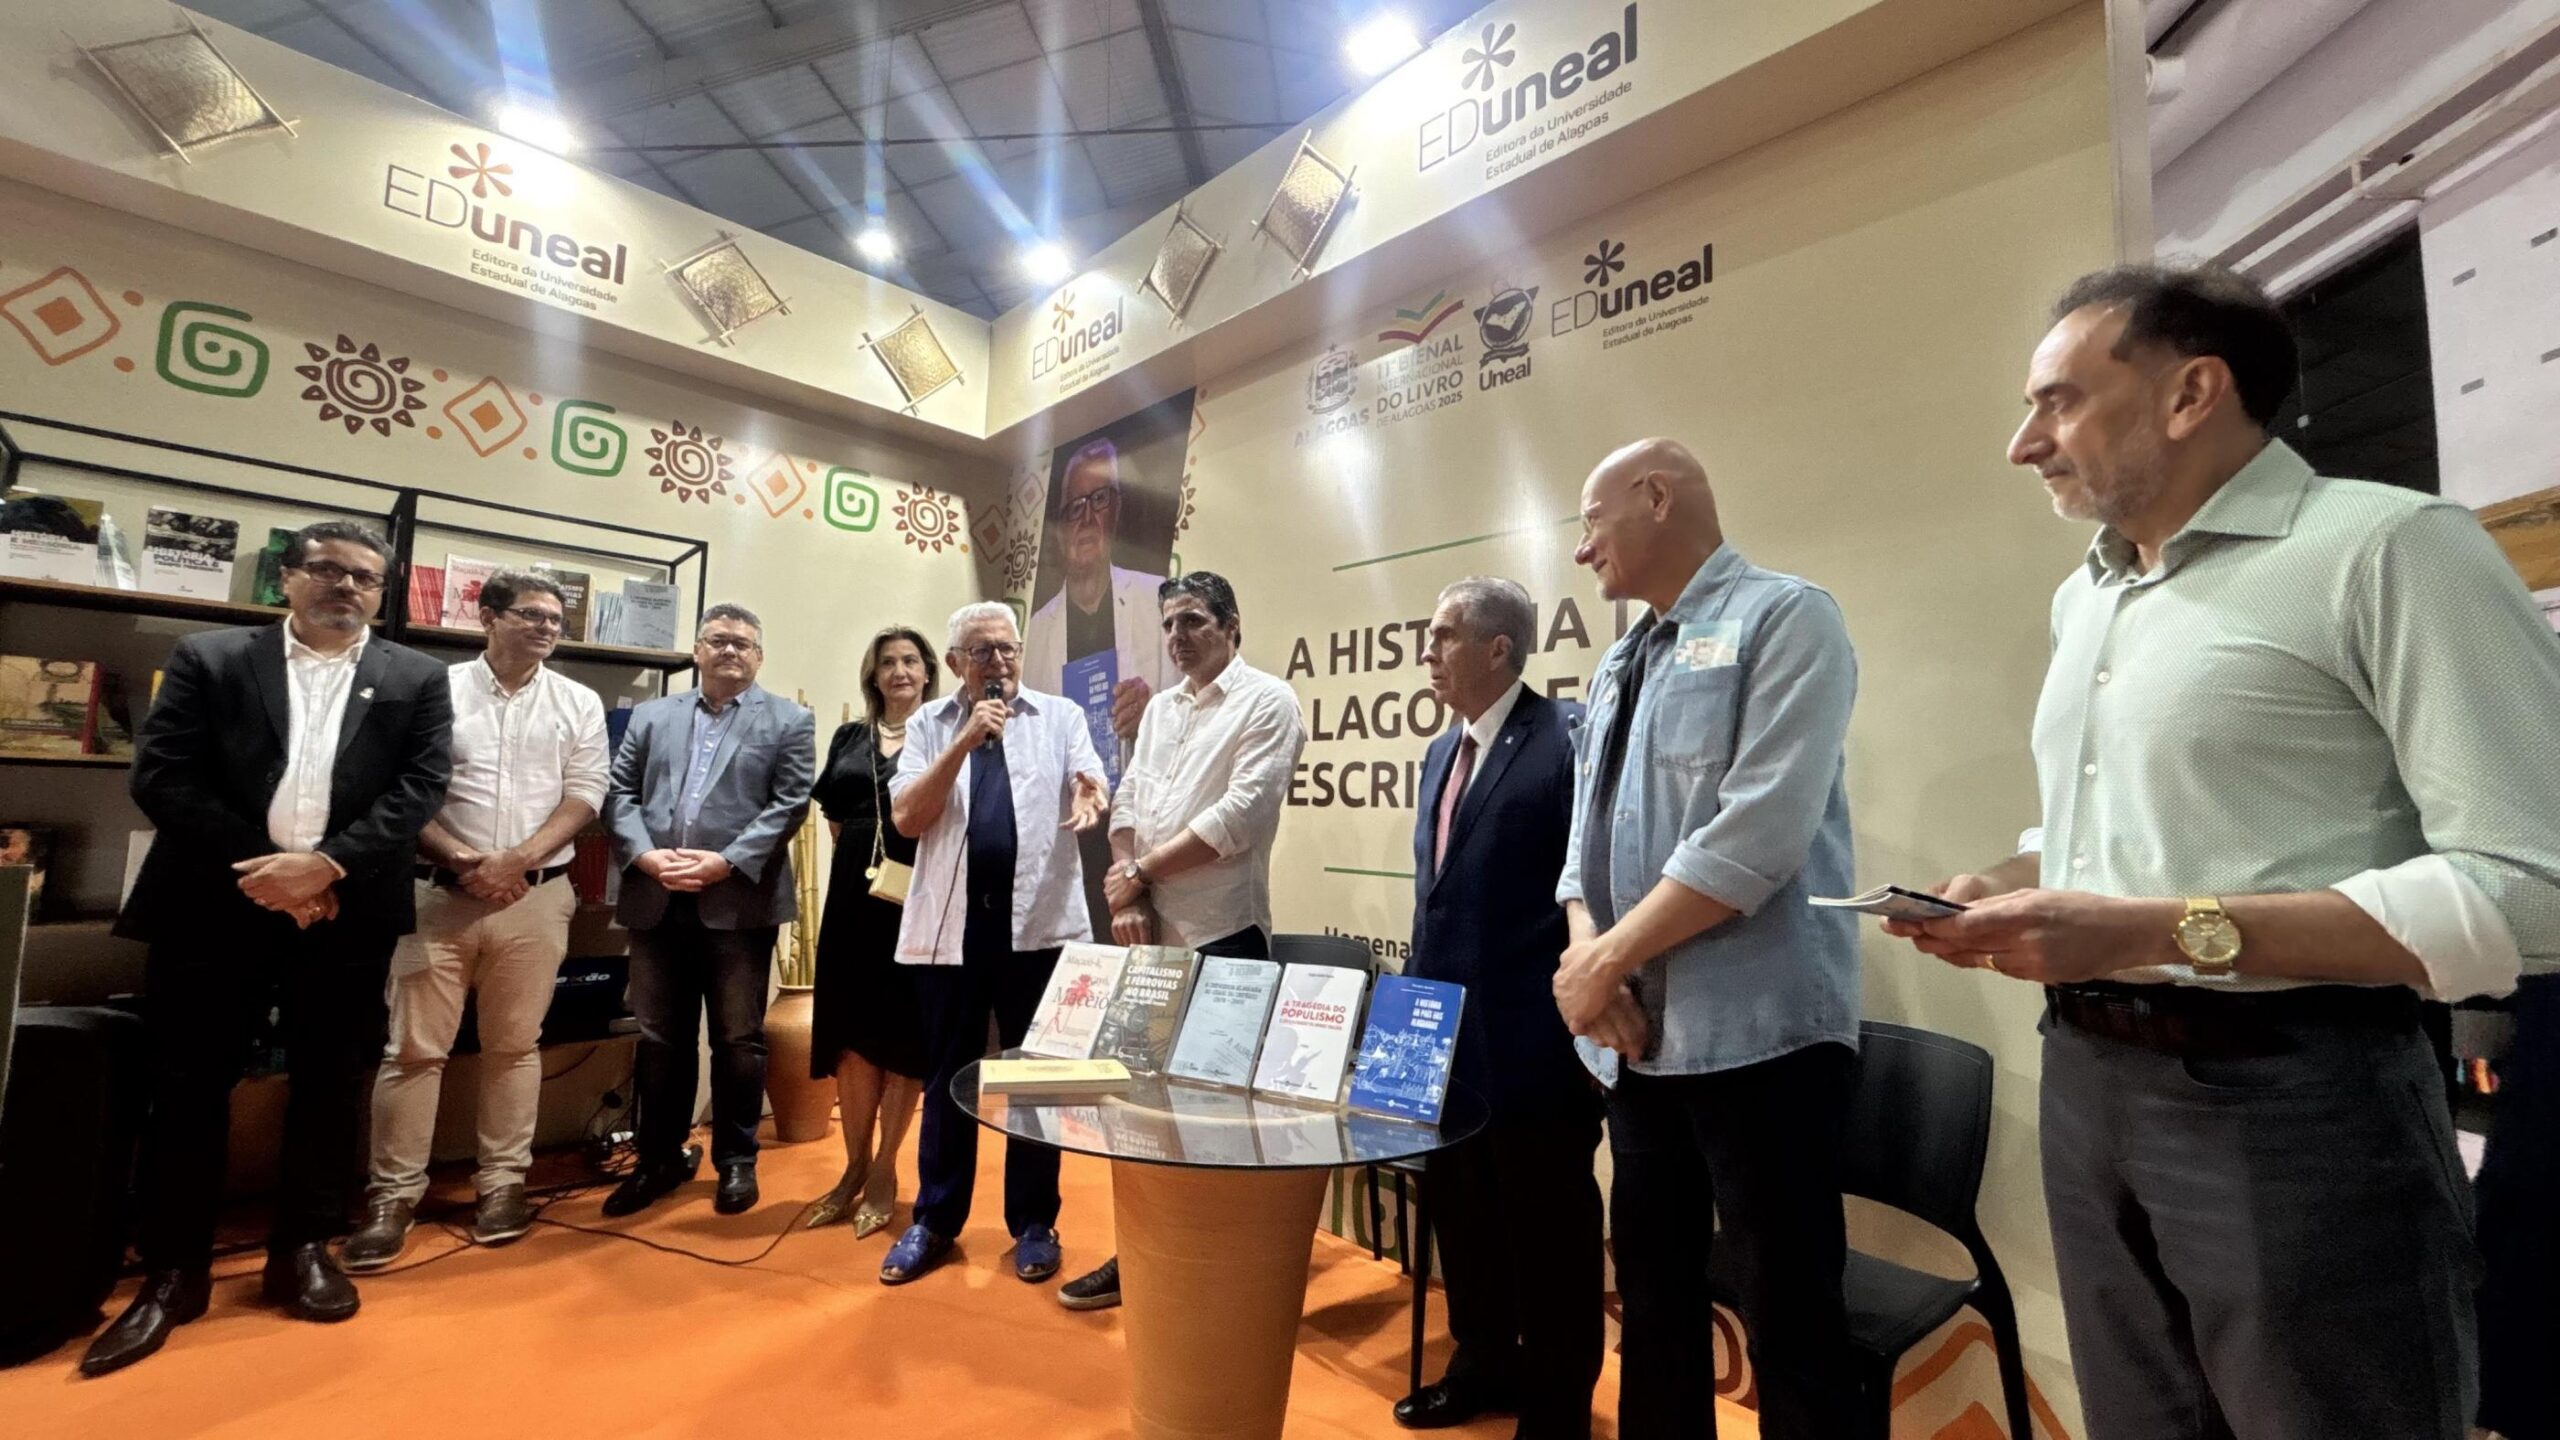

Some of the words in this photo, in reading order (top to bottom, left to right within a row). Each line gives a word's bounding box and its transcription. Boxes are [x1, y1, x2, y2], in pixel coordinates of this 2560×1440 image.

[1419, 1, 1638, 172] EDuneal
[1486, 136, 1527, 162] Editora
[1529, 126, 1545, 141] da
[1547, 81, 1632, 131] Universidade
[1486, 149, 1536, 181] Estadual
[1539, 138, 1554, 154] de
[1557, 111, 1610, 145] Alagoas
[384, 164, 628, 285] EDuneal
[471, 263, 528, 288] Estadual
[531, 281, 546, 295] de
[549, 288, 597, 311] Alagoas
[472, 249, 519, 272] Editora
[522, 265, 537, 278] da
[540, 270, 618, 304] Universidade
[1552, 243, 1713, 337] EDuneal
[1602, 330, 1641, 350] Estadual
[1643, 325, 1654, 337] de
[1656, 314, 1694, 333] Alagoas
[1603, 320, 1634, 338] Editora
[1635, 316, 1647, 327] da
[1648, 295, 1710, 322] Universidade
[1032, 296, 1123, 381] EDuneal
[1397, 334, 1464, 372] BIENAL
[1376, 358, 1463, 393] INTERNACIONAL
[1376, 392, 1402, 414] DO
[1407, 370, 1464, 404] LIVRO
[1479, 357, 1531, 391] Uneal
[1294, 408, 1370, 449] ALAGOAS
[1376, 416, 1388, 429] DE
[1390, 403, 1436, 424] ALAGOAS
[1438, 391, 1463, 409] 2025
[1286, 637, 1315, 680] A
[1287, 761, 1424, 808] ESCRI
[1127, 965, 1184, 979] CAPITALISMO
[1131, 975, 1179, 990] FERROVIAS
[1139, 987, 1170, 1001] BRASIL
[1281, 1007, 1345, 1024] POPULISMO
[1333, 1005, 1346, 1013] DO
